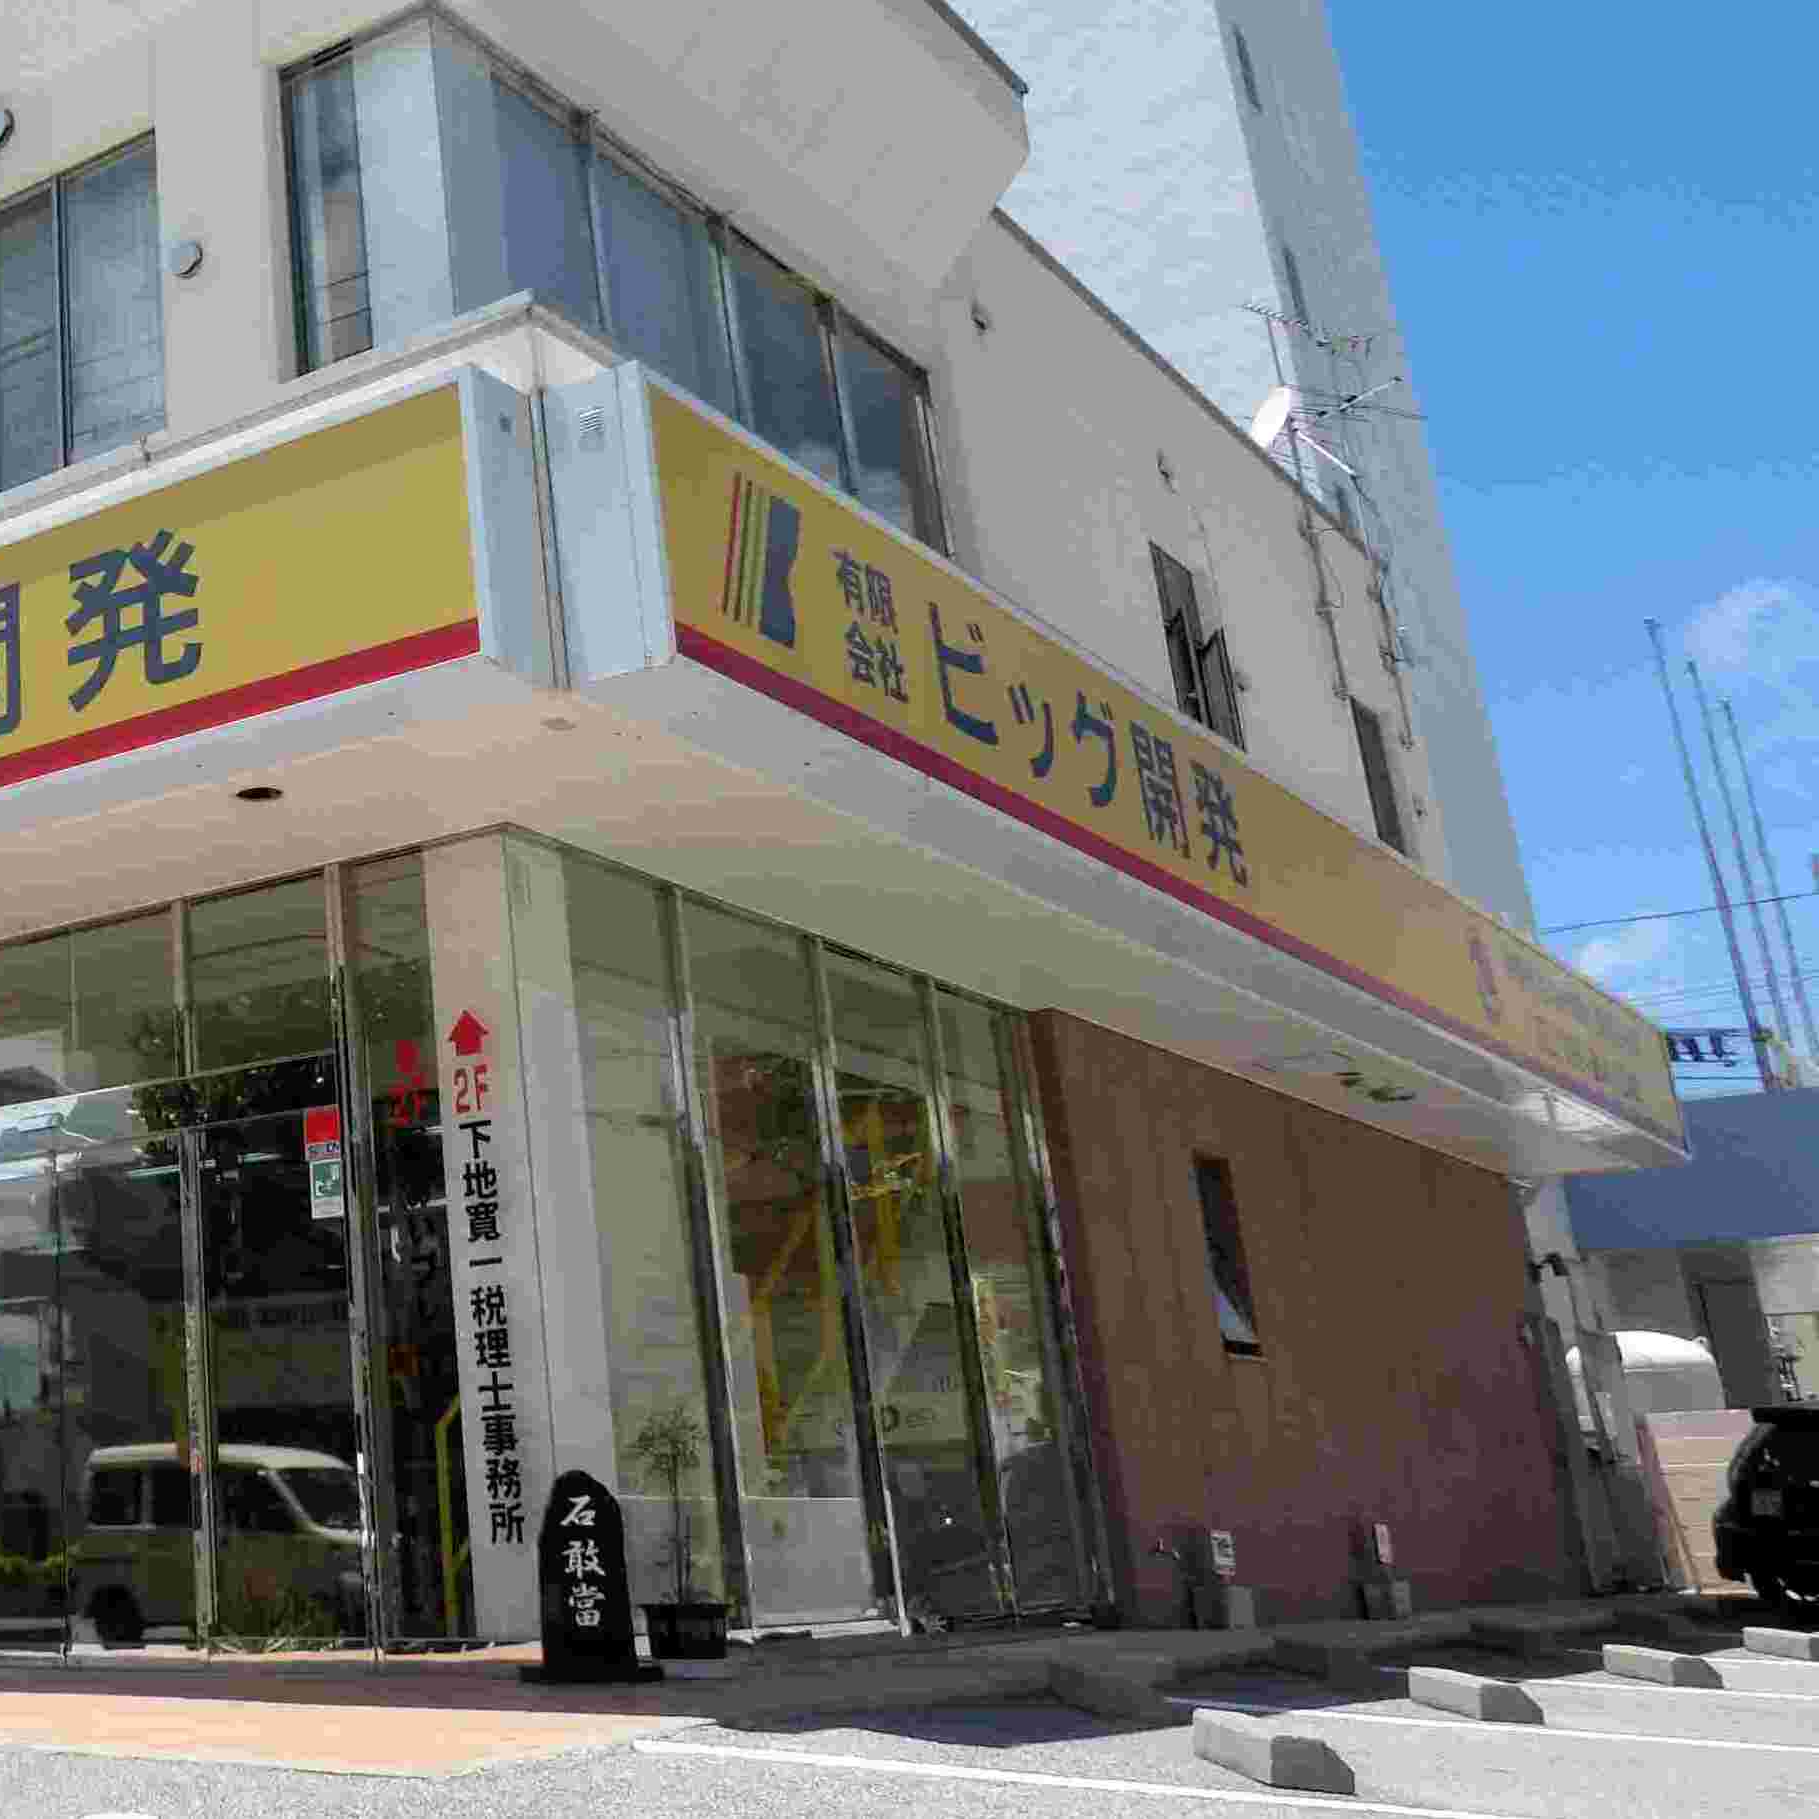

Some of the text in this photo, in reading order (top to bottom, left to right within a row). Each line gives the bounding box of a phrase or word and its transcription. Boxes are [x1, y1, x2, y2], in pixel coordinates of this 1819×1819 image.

[831, 549, 900, 635] 有限
[844, 620, 909, 703] 会社
[926, 600, 1249, 888] ビッグ開発
[453, 1064, 491, 1114] 2F
[560, 1495, 606, 1627] 石敢當
